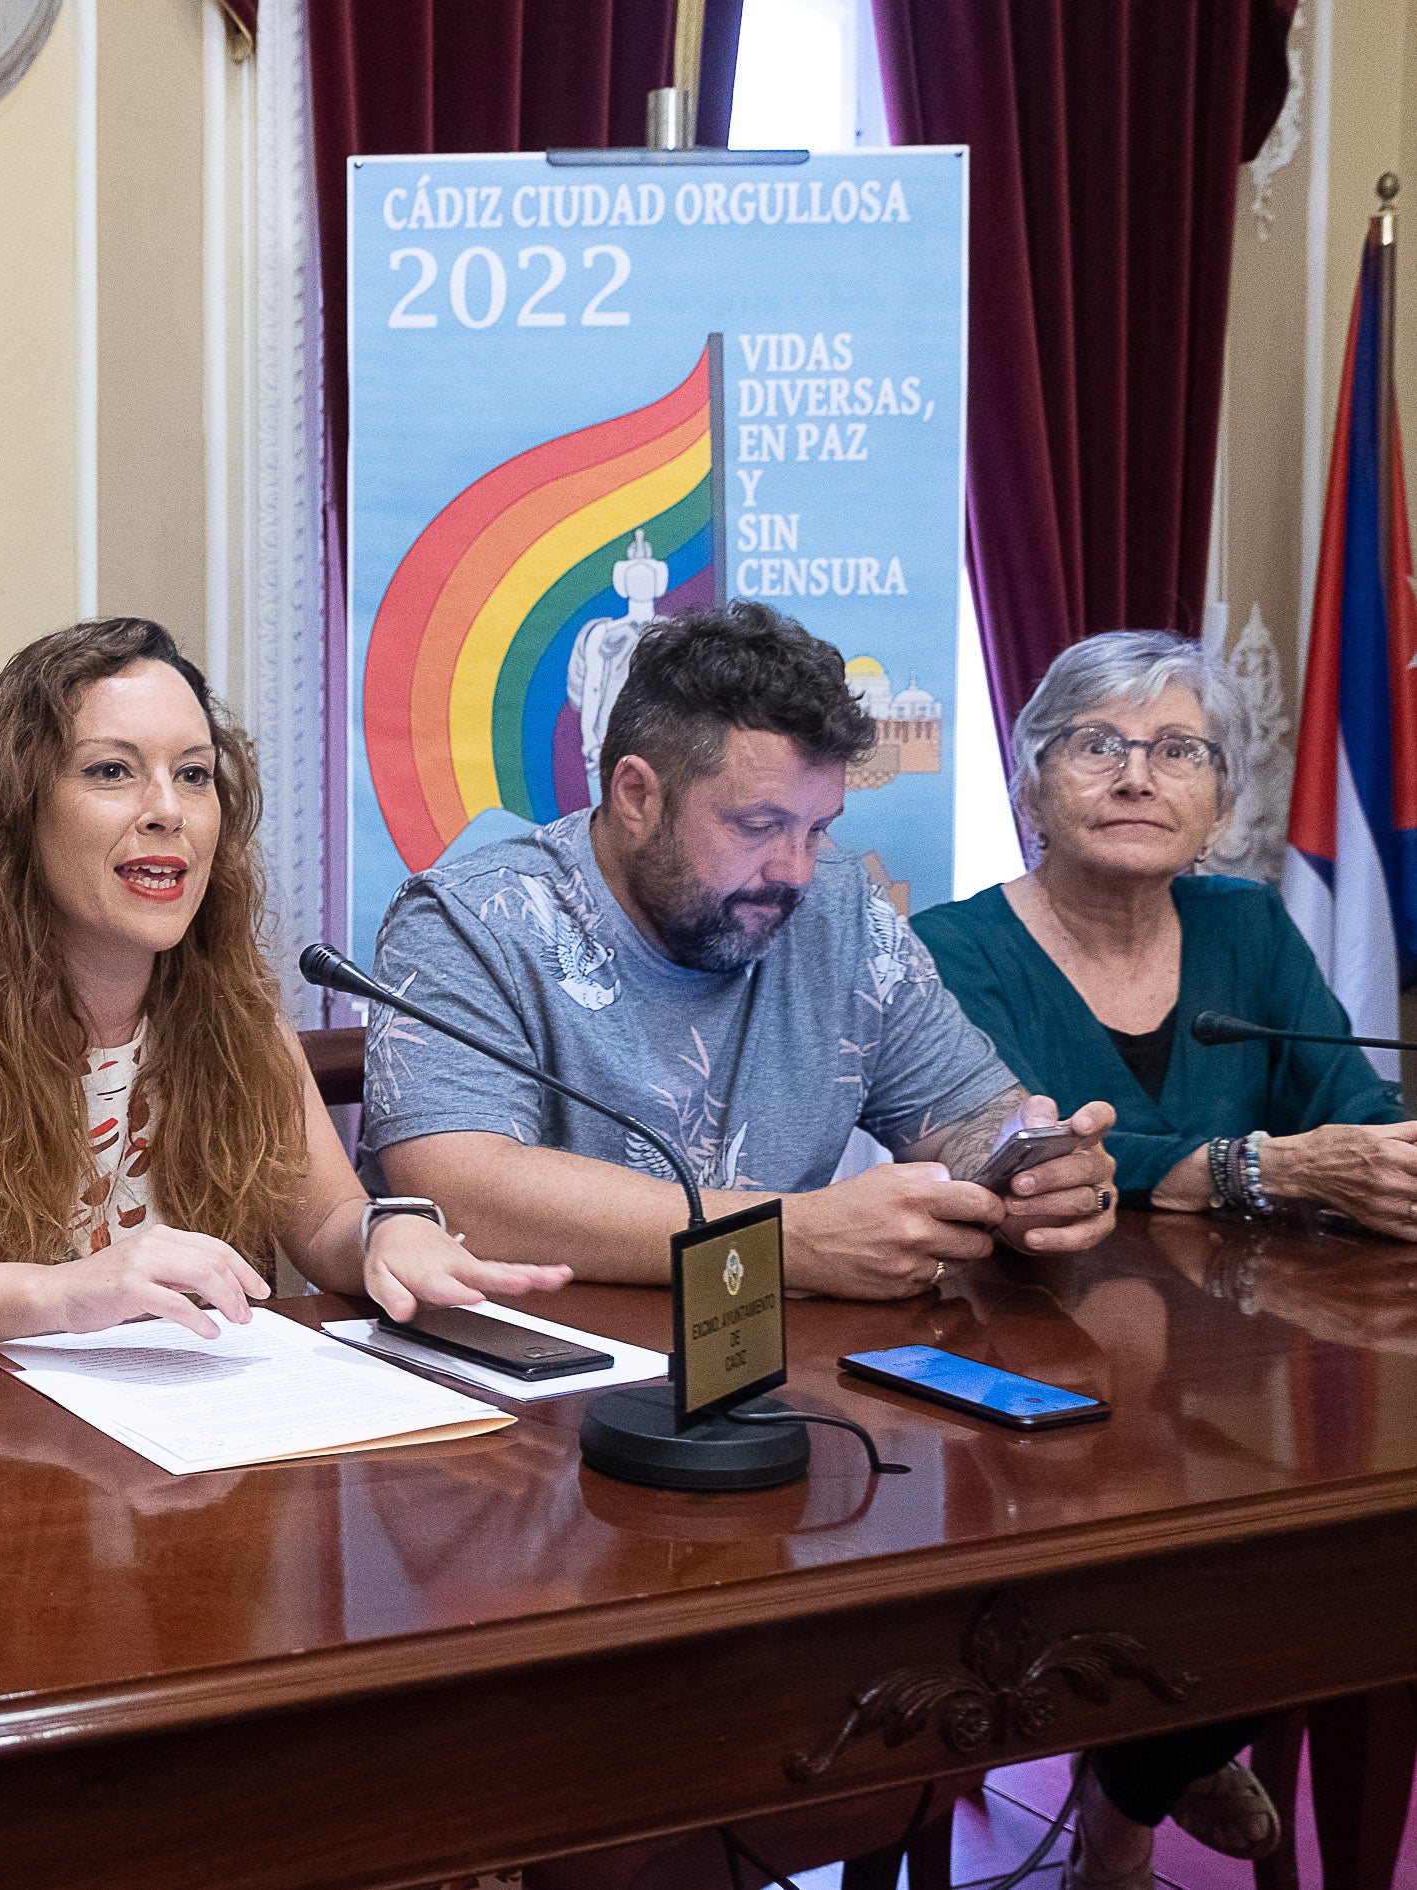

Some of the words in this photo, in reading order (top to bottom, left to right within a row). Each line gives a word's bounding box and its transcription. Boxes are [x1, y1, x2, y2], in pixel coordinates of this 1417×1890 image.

[384, 175, 502, 230] CÁDIZ
[512, 183, 665, 228] CIUDAD
[675, 179, 911, 225] ORGULLOSA
[387, 244, 632, 329] 2022
[740, 332, 854, 373] VIDAS
[738, 377, 935, 422] DIVERSAS,
[739, 424, 786, 464] EN
[796, 423, 868, 462] PAZ
[737, 469, 763, 507] Y
[738, 513, 800, 552] SIN
[737, 556, 907, 596] CENSURA
